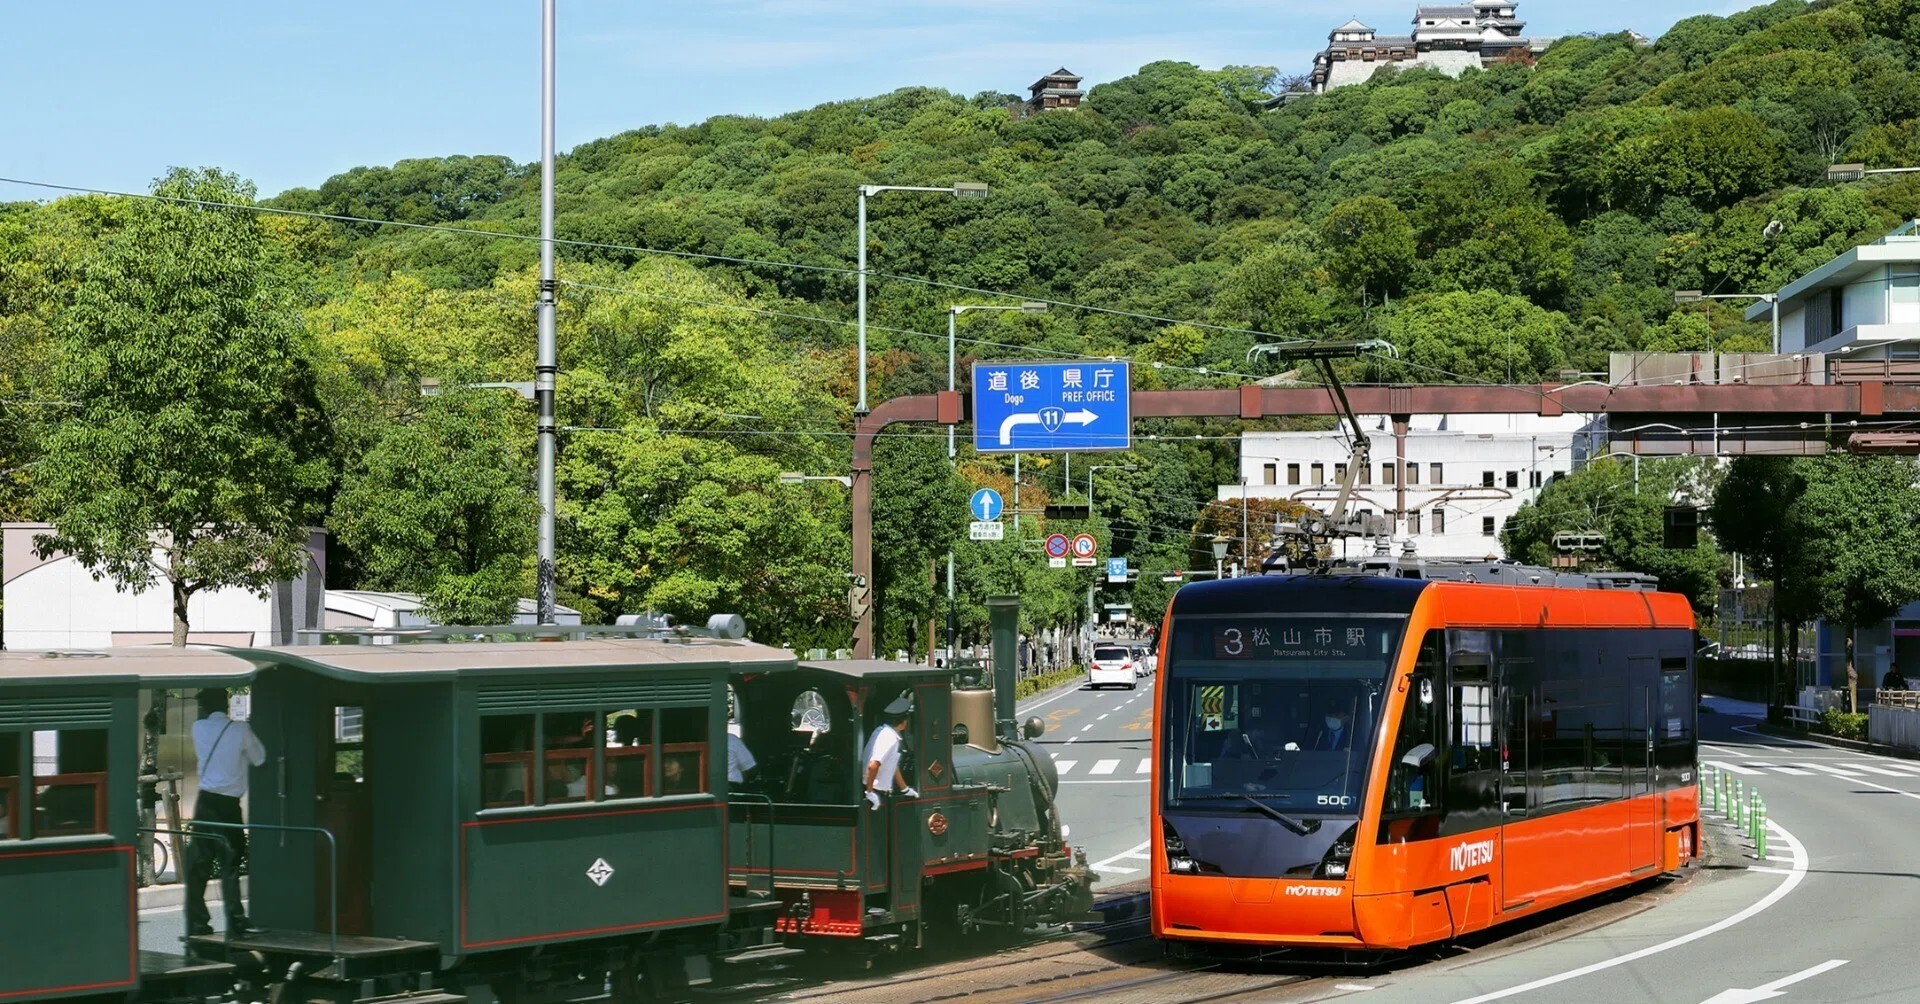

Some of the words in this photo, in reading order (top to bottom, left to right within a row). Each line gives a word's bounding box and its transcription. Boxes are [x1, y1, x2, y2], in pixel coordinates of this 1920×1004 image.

[988, 370, 1040, 391] 道後
[1062, 367, 1114, 388] 県庁
[1004, 393, 1024, 406] Dogo
[1062, 391, 1085, 402] PREF.
[1086, 390, 1115, 402] OFFICE
[1043, 411, 1058, 425] 11
[1223, 628, 1244, 655] 3
[1251, 627, 1366, 647] 松山市駅
[1450, 839, 1494, 872] IYOTETSU
[1285, 884, 1342, 897] IYOTETSU
